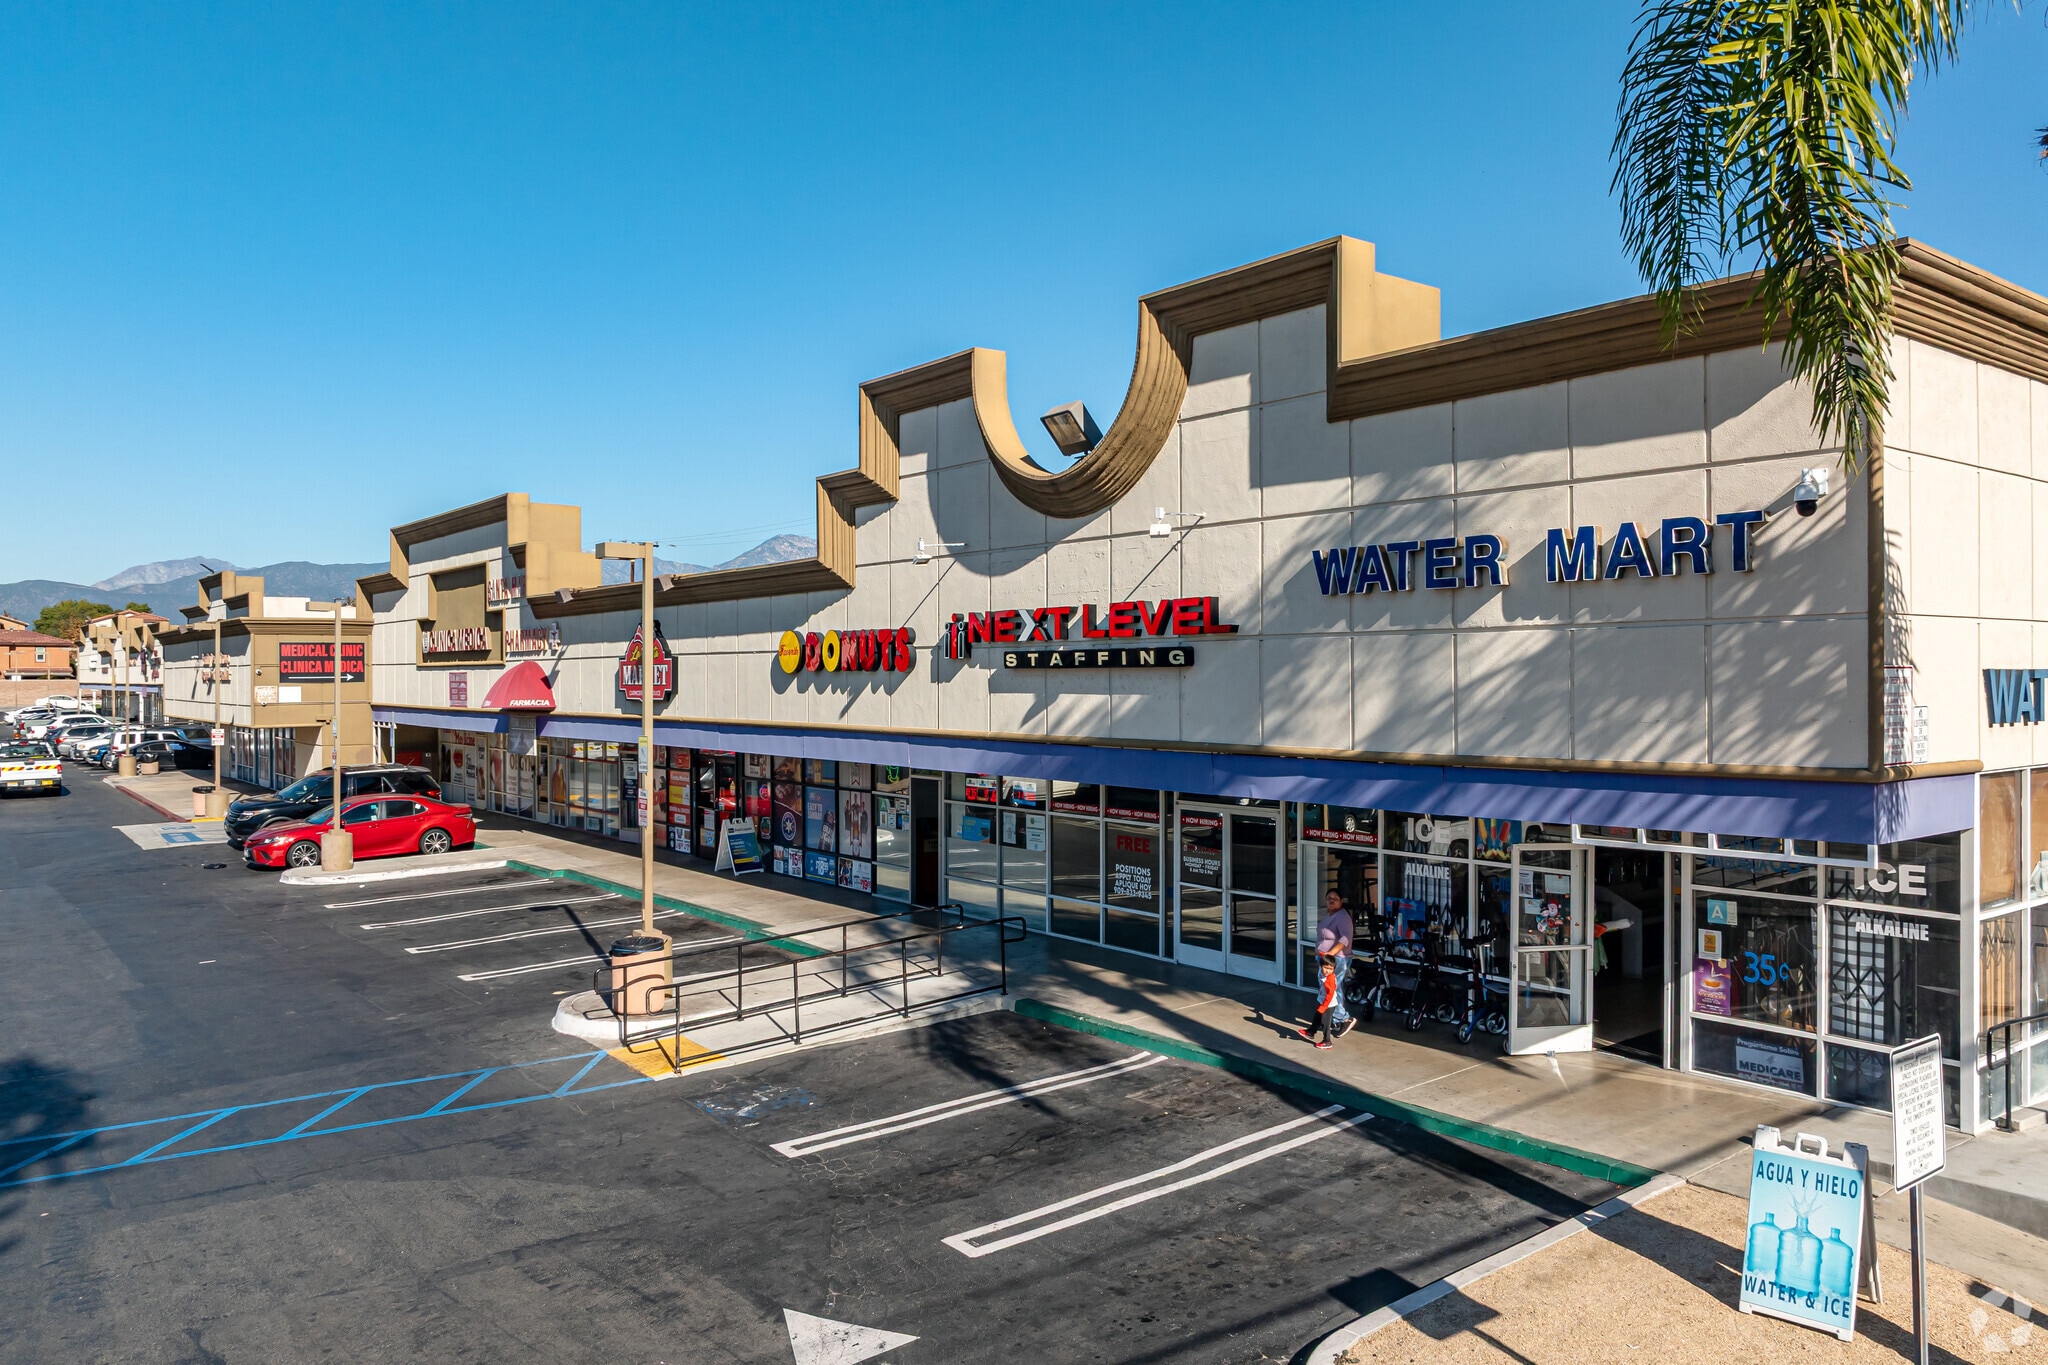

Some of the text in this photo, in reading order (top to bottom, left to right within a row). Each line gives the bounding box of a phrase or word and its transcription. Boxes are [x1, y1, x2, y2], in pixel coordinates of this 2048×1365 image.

[1312, 510, 1770, 596] WATER MART
[968, 596, 1239, 643] NEXT LEVEL
[281, 644, 363, 656] MEDICAL CINIC
[430, 627, 488, 653] CLINICA MEDICA
[506, 628, 548, 652] PHARMACY
[805, 627, 915, 673] DONUTS
[280, 660, 364, 673] CLINICA MDICA
[1006, 648, 1186, 668] STAFFING
[1322, 831, 1338, 839] HIRING
[1356, 834, 1373, 842] HIRING
[1408, 818, 1451, 844] ICE
[1116, 835, 1150, 853] FREE
[1115, 864, 1151, 876] POSITIONS
[1183, 856, 1220, 867] BUSINESS HOURS
[1405, 863, 1450, 880] ALKALINE
[1115, 880, 1138, 890] APLIQUE
[1133, 875, 1151, 884] TODAY
[1854, 862, 1926, 896] ICE
[1711, 904, 1724, 919] A
[1855, 916, 1929, 941] ALKALINE
[1743, 951, 1790, 986] 35¢
[1739, 1061, 1801, 1080] MEDICARE
[1756, 1160, 1858, 1199] AGUA Y HIELO
[1744, 1274, 1851, 1319] WATER & ICE
